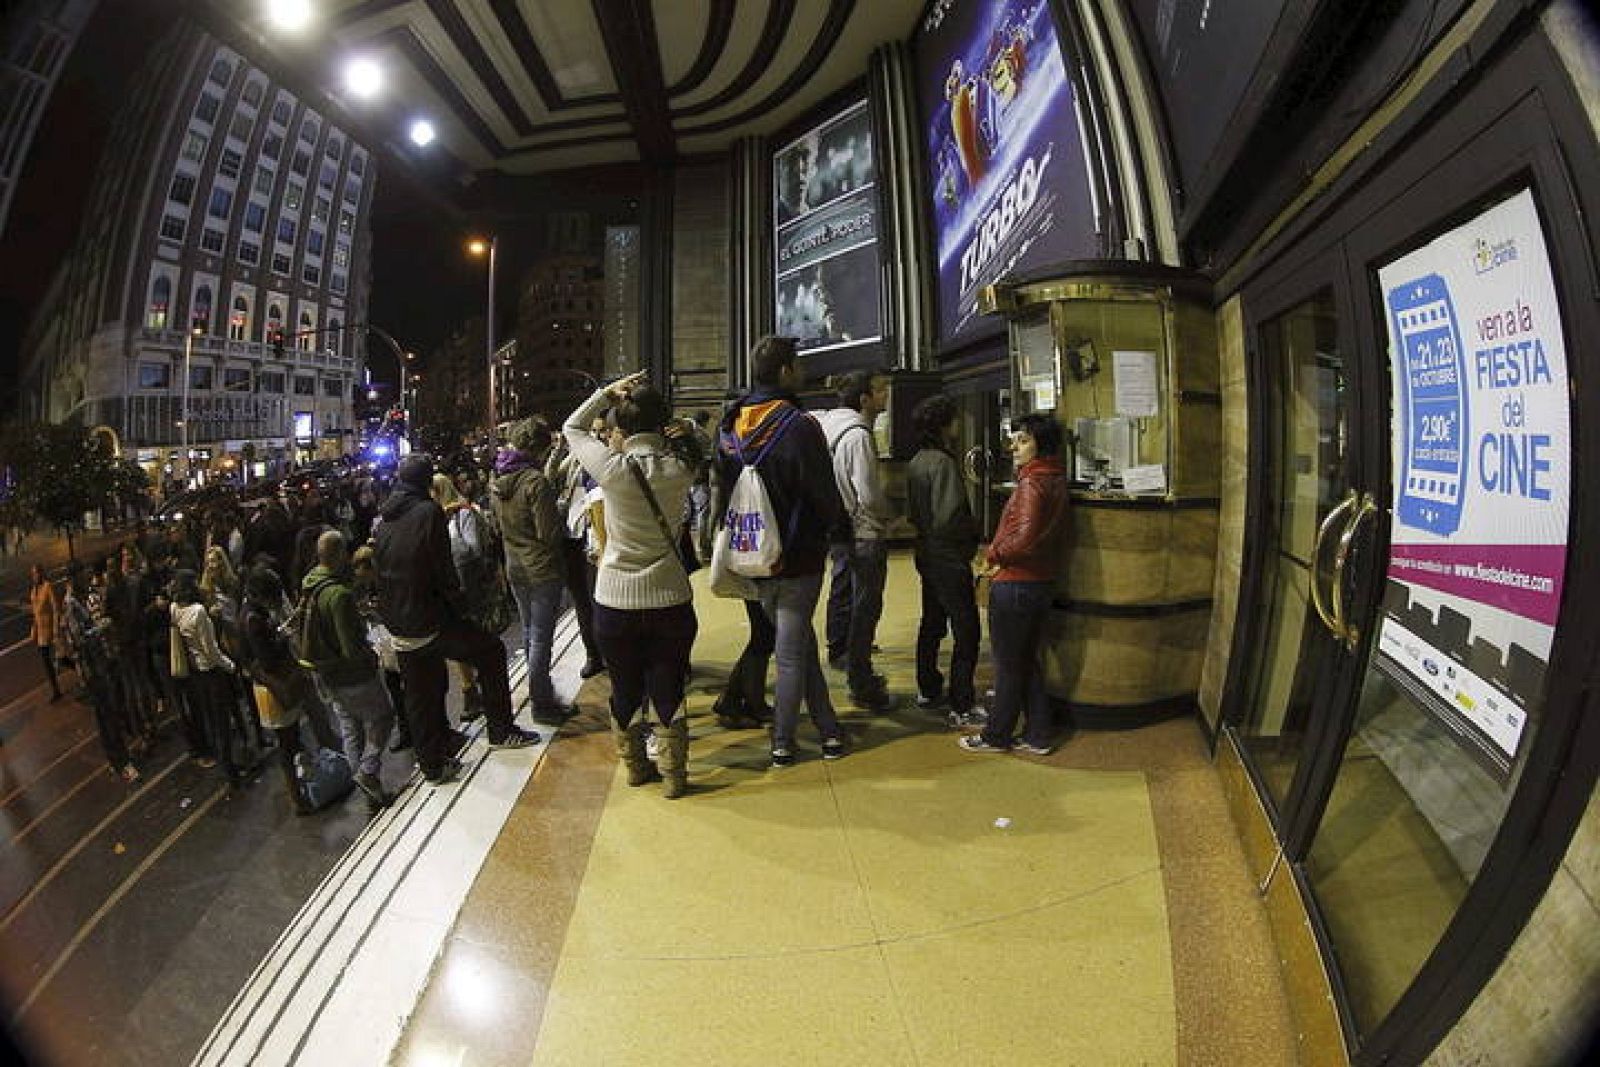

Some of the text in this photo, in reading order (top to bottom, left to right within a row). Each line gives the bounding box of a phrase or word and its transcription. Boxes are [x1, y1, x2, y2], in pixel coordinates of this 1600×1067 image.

[960, 141, 1054, 296] TURBO
[1477, 299, 1533, 342] ven a la
[1418, 341, 1432, 369] 21
[1475, 338, 1552, 389] FIESTA
[1502, 391, 1526, 428] del
[1480, 432, 1552, 501] CINE
